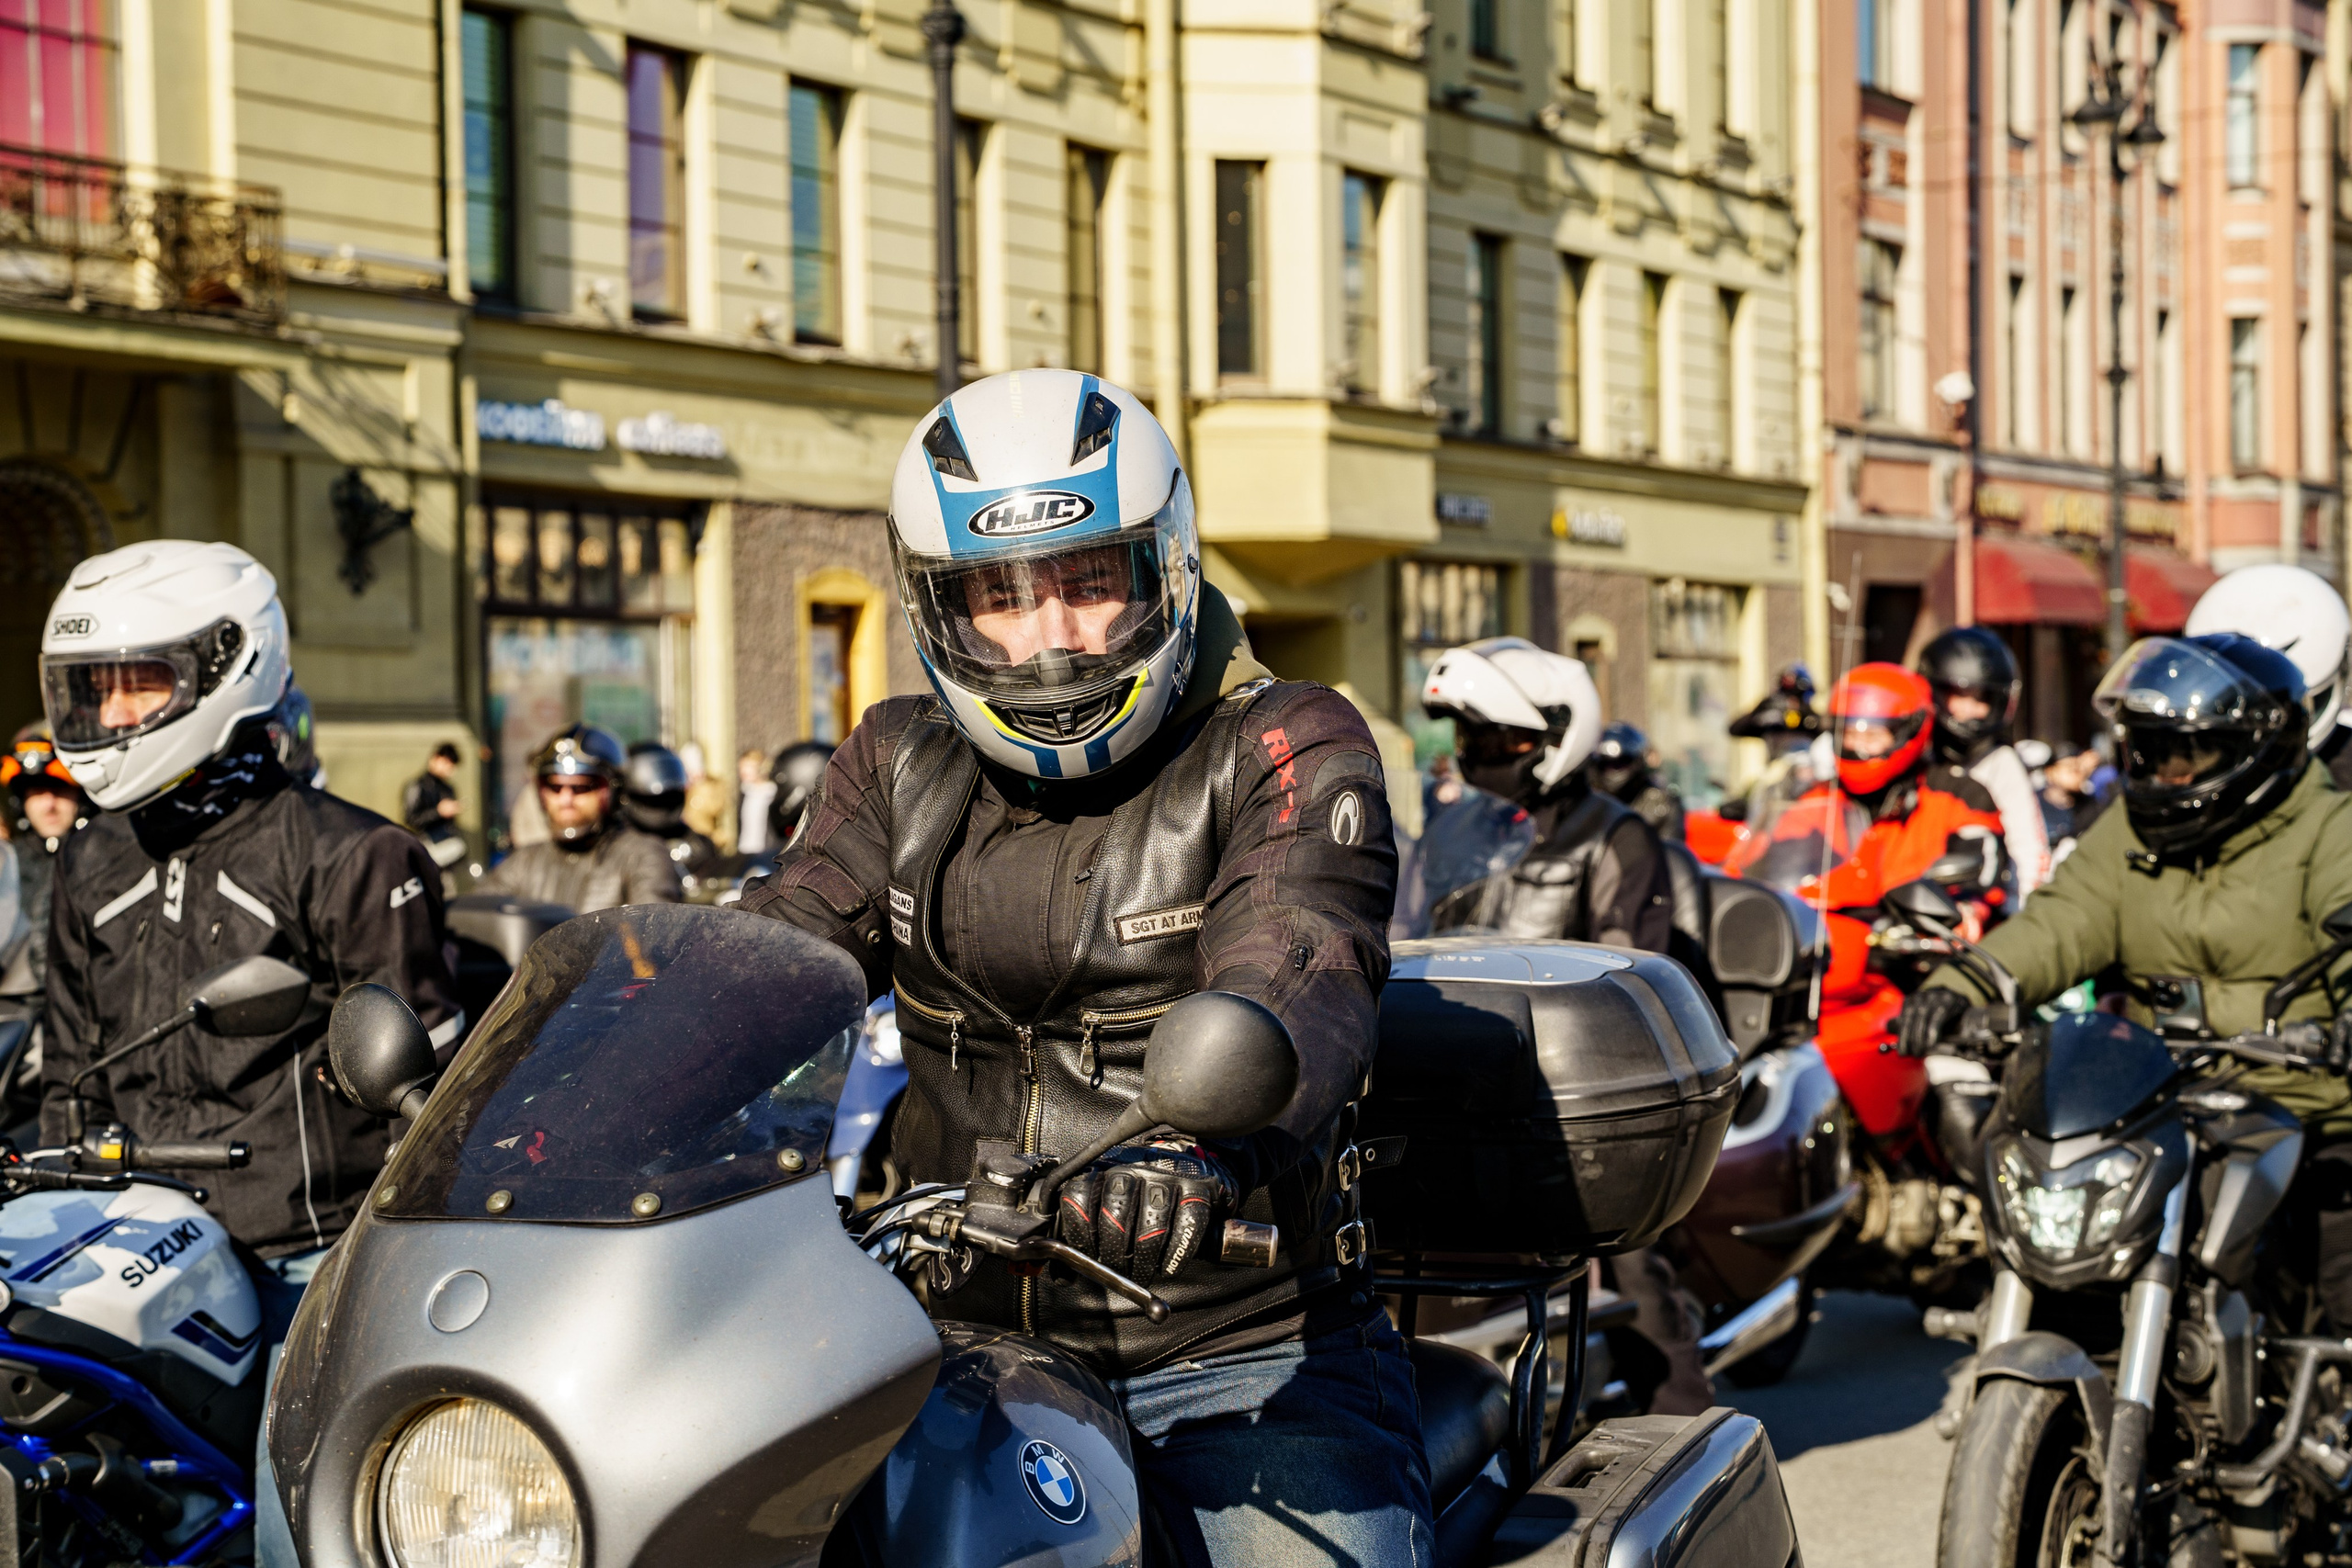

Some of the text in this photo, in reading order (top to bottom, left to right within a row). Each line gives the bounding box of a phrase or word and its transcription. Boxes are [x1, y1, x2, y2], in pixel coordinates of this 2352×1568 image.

[985, 498, 1078, 532] HJC
[1011, 520, 1056, 531] HELMETS
[53, 618, 90, 635] SHOEI
[164, 857, 187, 923] LS2
[390, 876, 423, 908] LS
[1130, 919, 1157, 934] SGT
[1160, 915, 1176, 930] AT
[120, 1219, 204, 1288] SUZUKI
[1024, 1443, 1065, 1475] BMW
